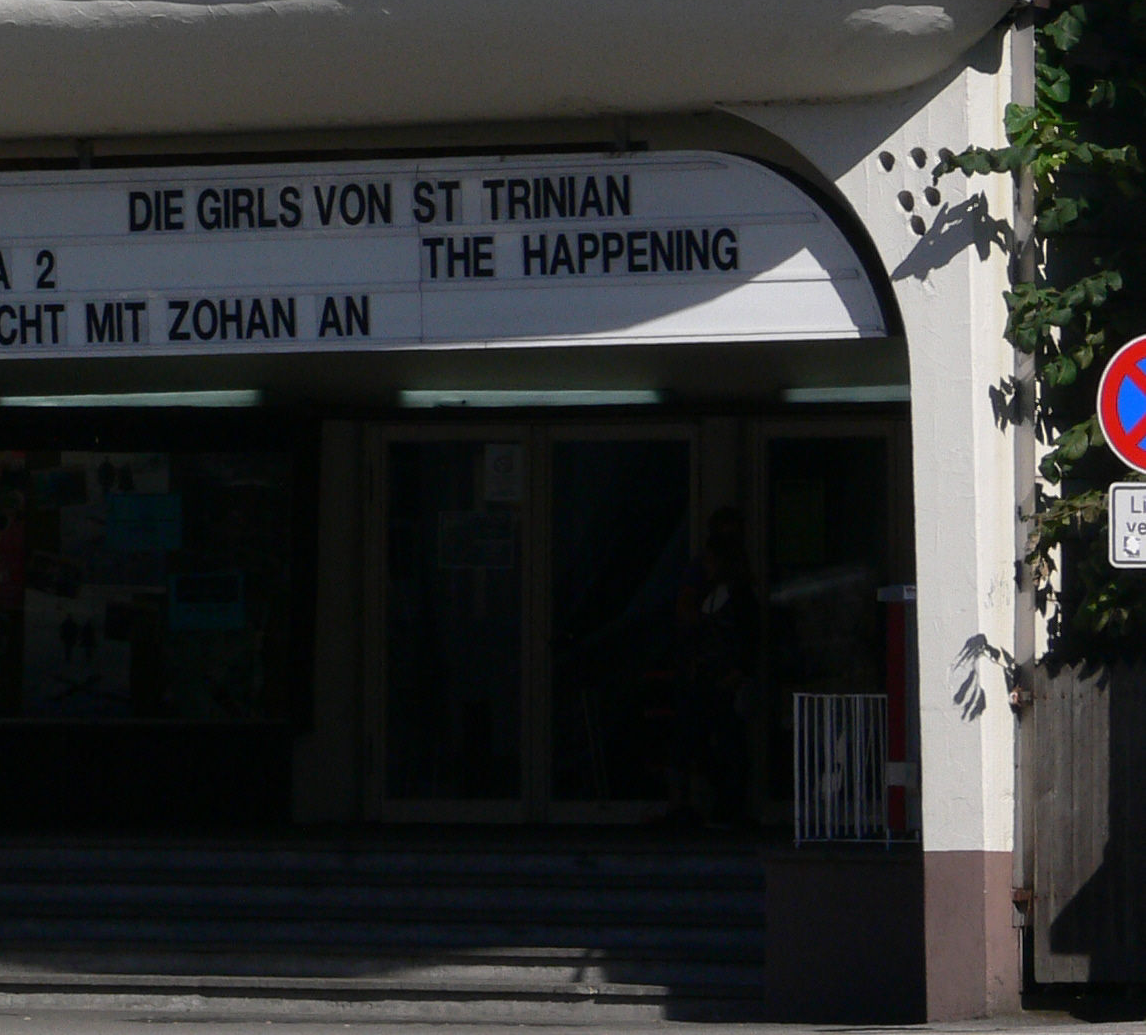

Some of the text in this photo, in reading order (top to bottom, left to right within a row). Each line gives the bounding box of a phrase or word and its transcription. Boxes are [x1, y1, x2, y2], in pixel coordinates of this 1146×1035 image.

[128, 174, 631, 233] DIE GIRLS VON ST TRINIAN
[36, 249, 56, 290] 2
[421, 227, 739, 279] THE HAPPENING
[85, 301, 147, 344] MIT
[168, 297, 297, 341] ZOHAN
[318, 294, 370, 338] AN
